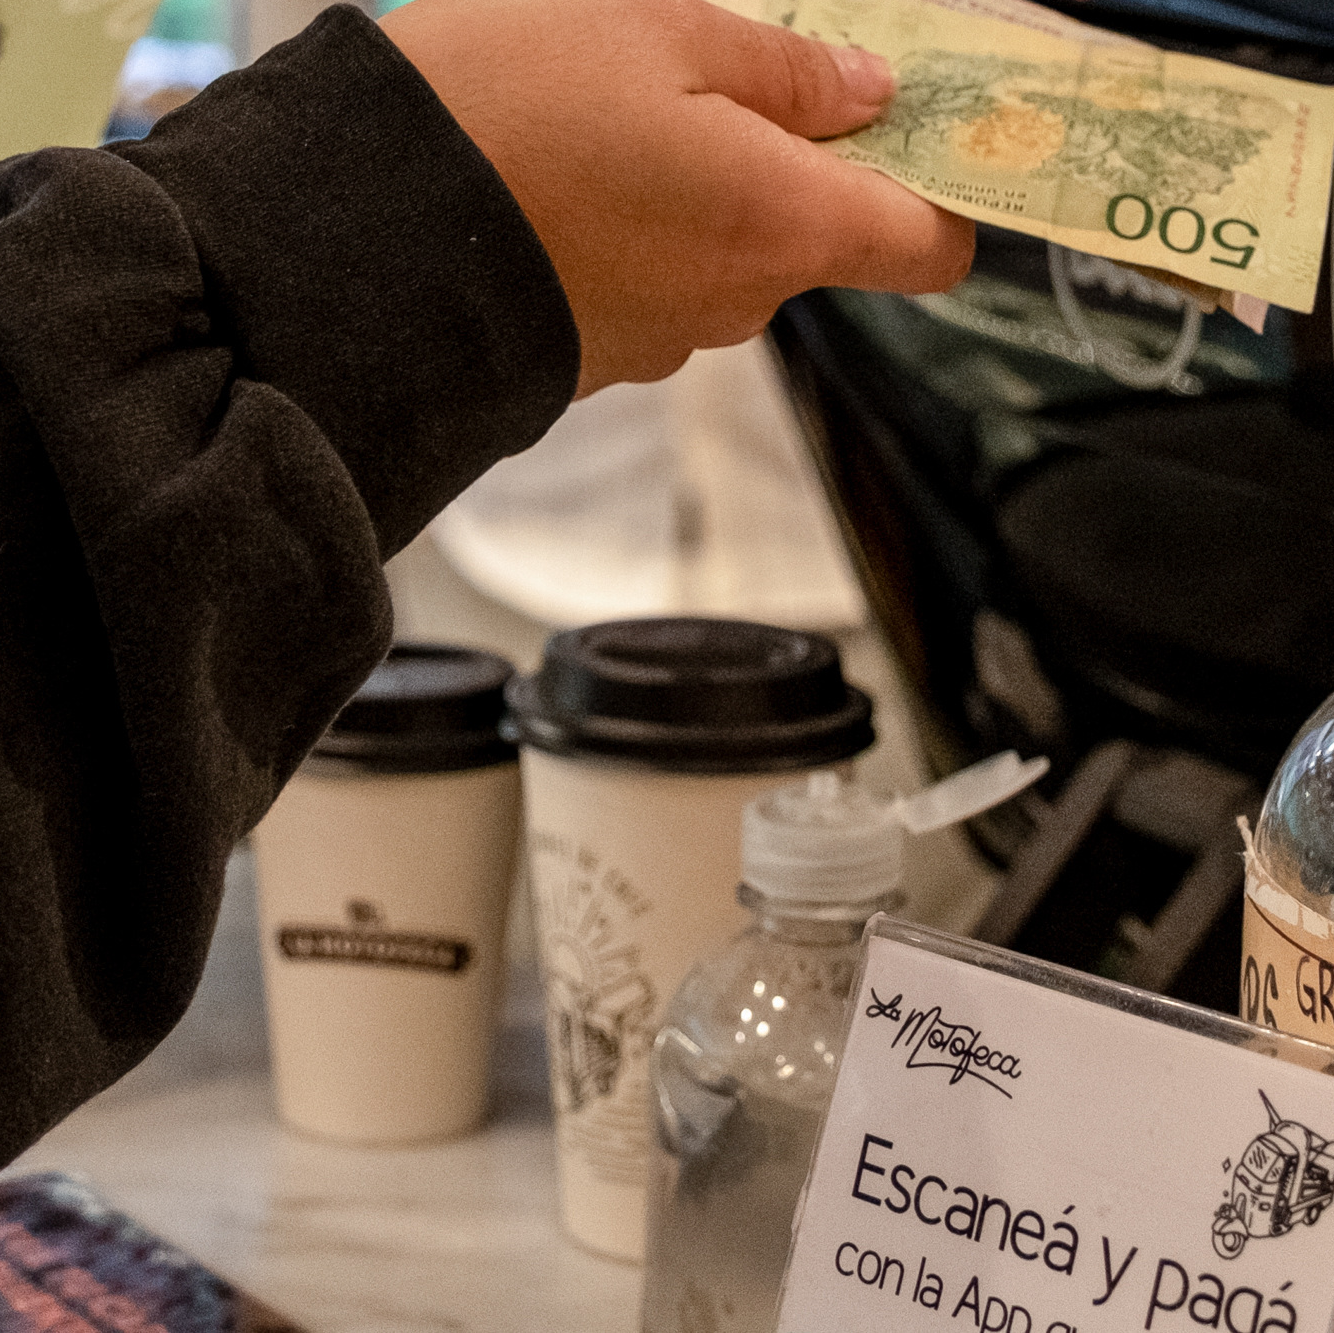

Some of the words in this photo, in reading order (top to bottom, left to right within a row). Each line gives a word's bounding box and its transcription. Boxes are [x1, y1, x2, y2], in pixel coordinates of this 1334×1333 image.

[1105, 193, 1260, 270] 500
[865, 987, 903, 1022] La
[850, 1133, 1080, 1276] Escaneá
[1093, 1235, 1139, 1307] y
[835, 1241, 905, 1296] con
[912, 1256, 945, 1311] la
